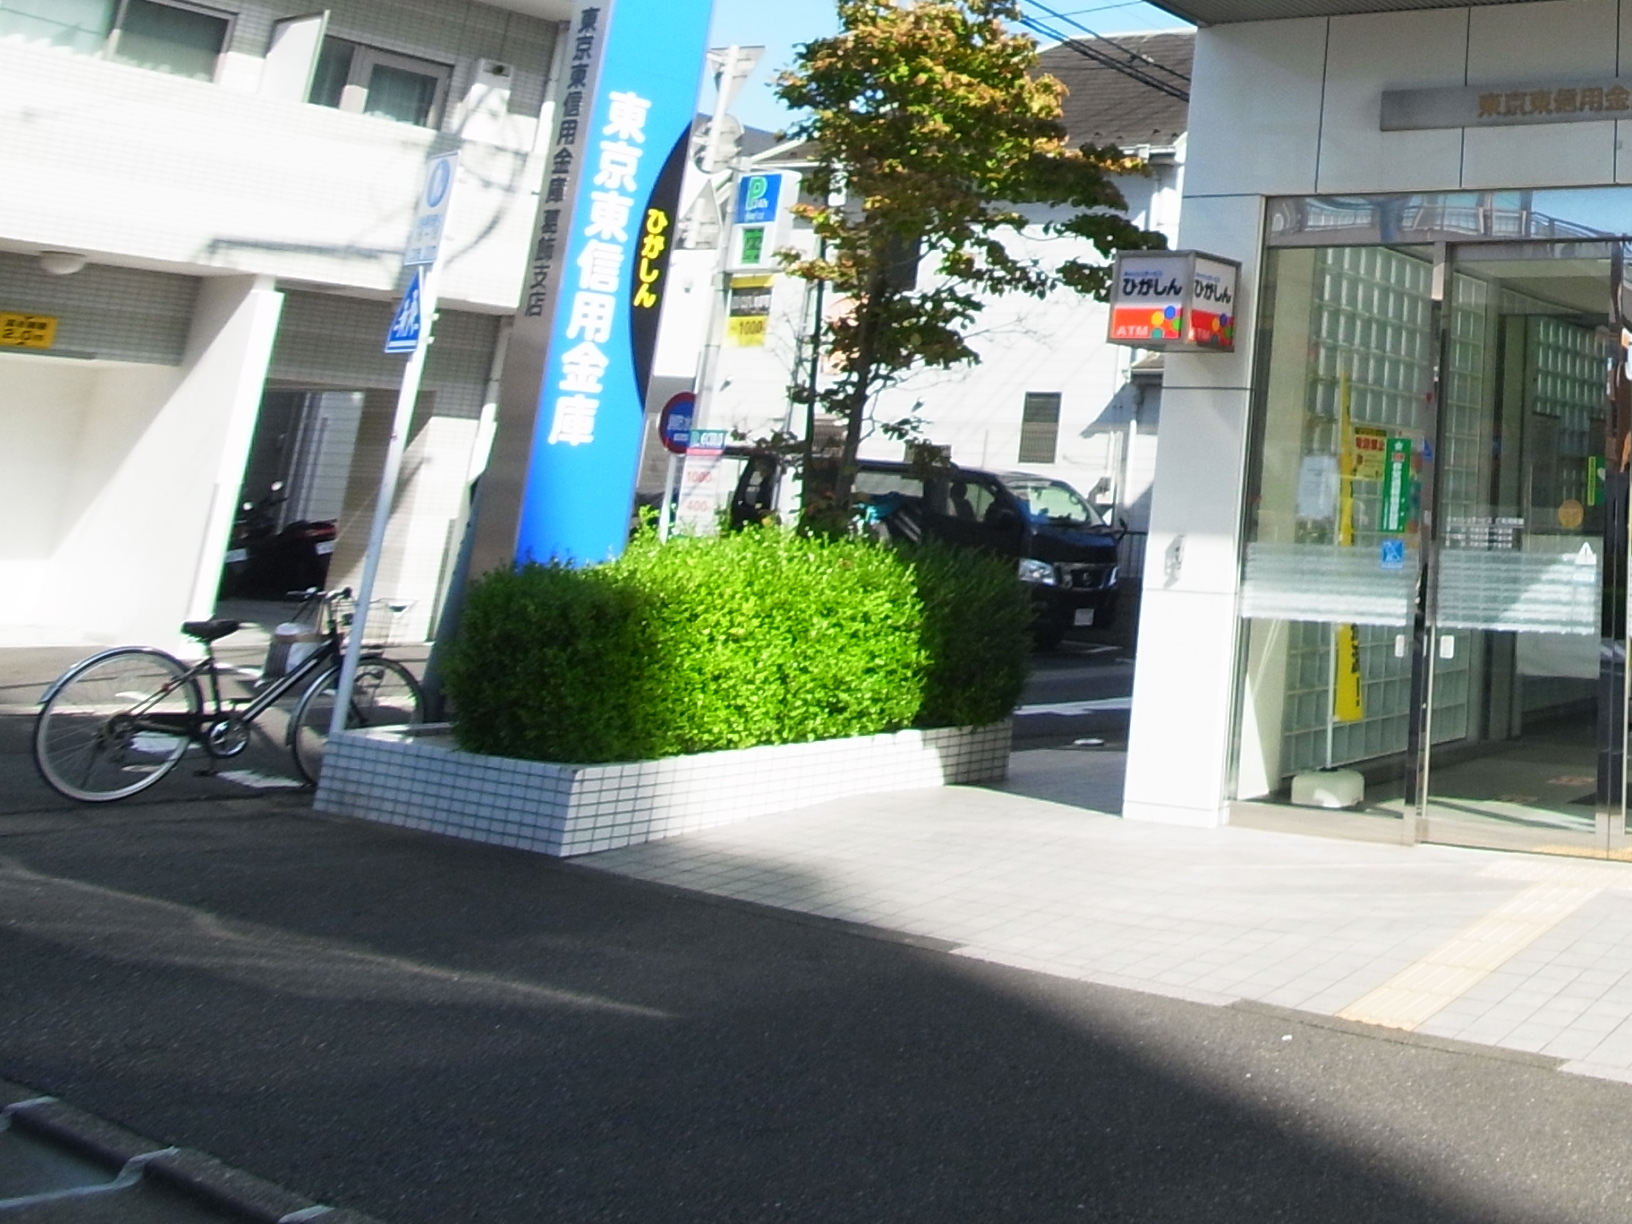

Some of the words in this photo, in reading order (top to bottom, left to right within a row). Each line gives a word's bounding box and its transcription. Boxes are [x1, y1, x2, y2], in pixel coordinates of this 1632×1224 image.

[547, 89, 652, 448] 東京東信用金庫
[632, 207, 669, 310] ひがしん
[1122, 278, 1182, 296] ひがしん
[1193, 279, 1232, 304] ひがしん
[1116, 325, 1149, 337] ATM
